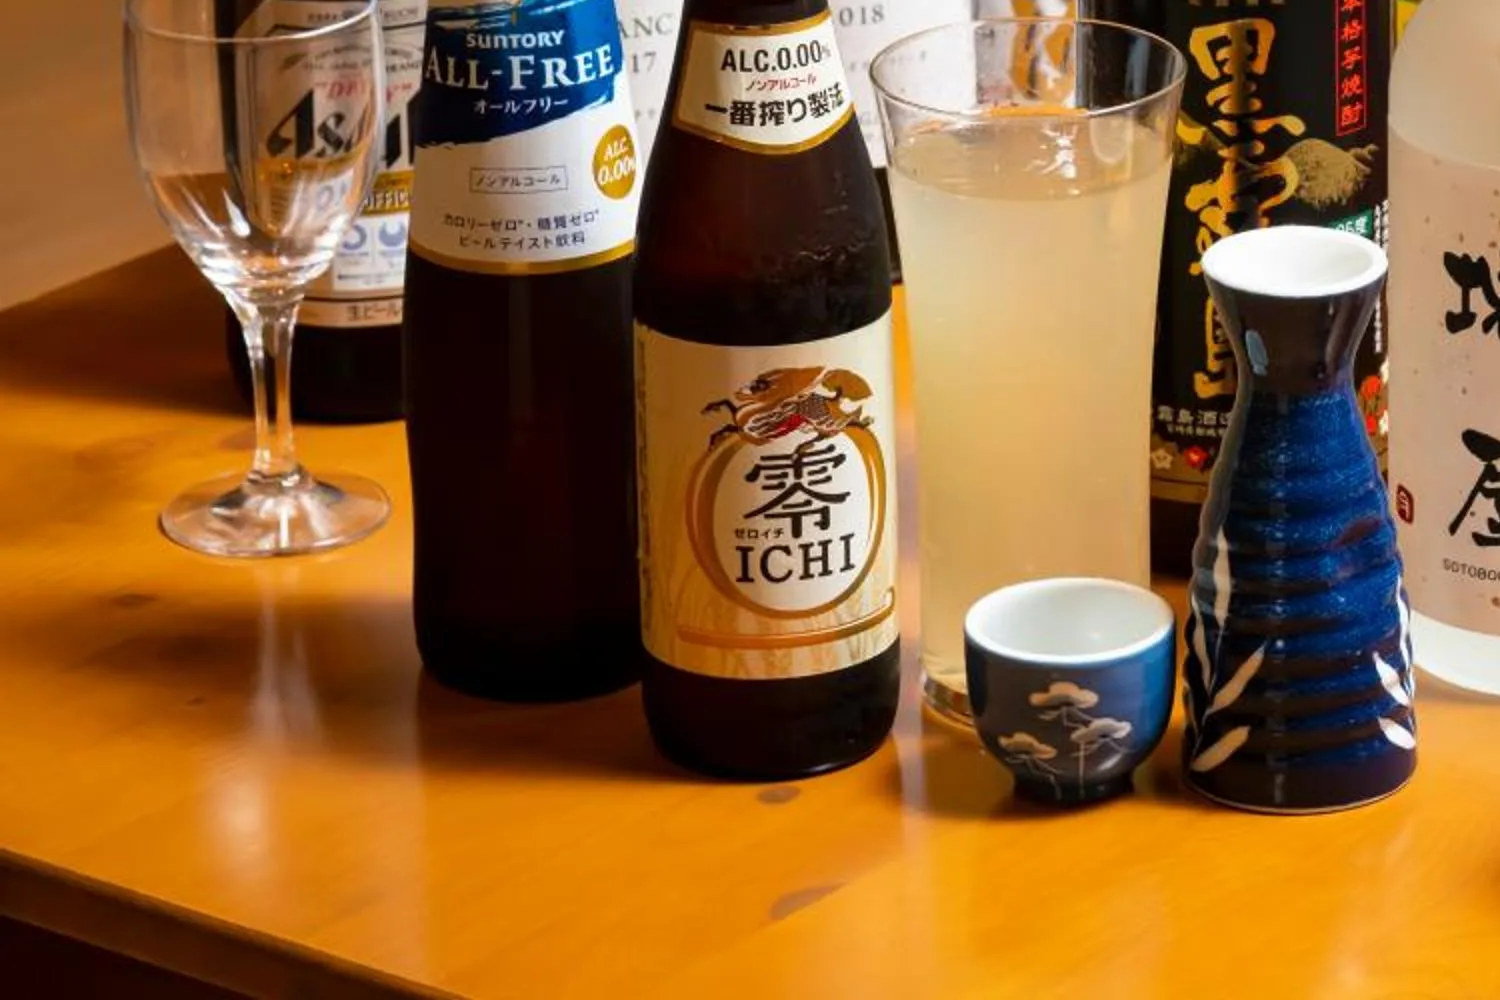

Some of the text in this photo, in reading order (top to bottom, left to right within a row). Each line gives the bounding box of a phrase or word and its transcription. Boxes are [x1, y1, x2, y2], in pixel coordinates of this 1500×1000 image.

[838, 4, 886, 28] 018
[424, 43, 615, 90] ALL-FREE
[631, 52, 657, 74] 17
[746, 75, 818, 92] ノンアルコール
[474, 95, 570, 115] オールフリー
[704, 80, 843, 127] 一番搾り製法
[474, 173, 562, 188] ノンアルコール
[459, 231, 587, 250] ビールテイスト飲料
[743, 437, 852, 538] 零
[734, 527, 785, 539] ゼロイチ
[734, 533, 856, 585] ICHI
